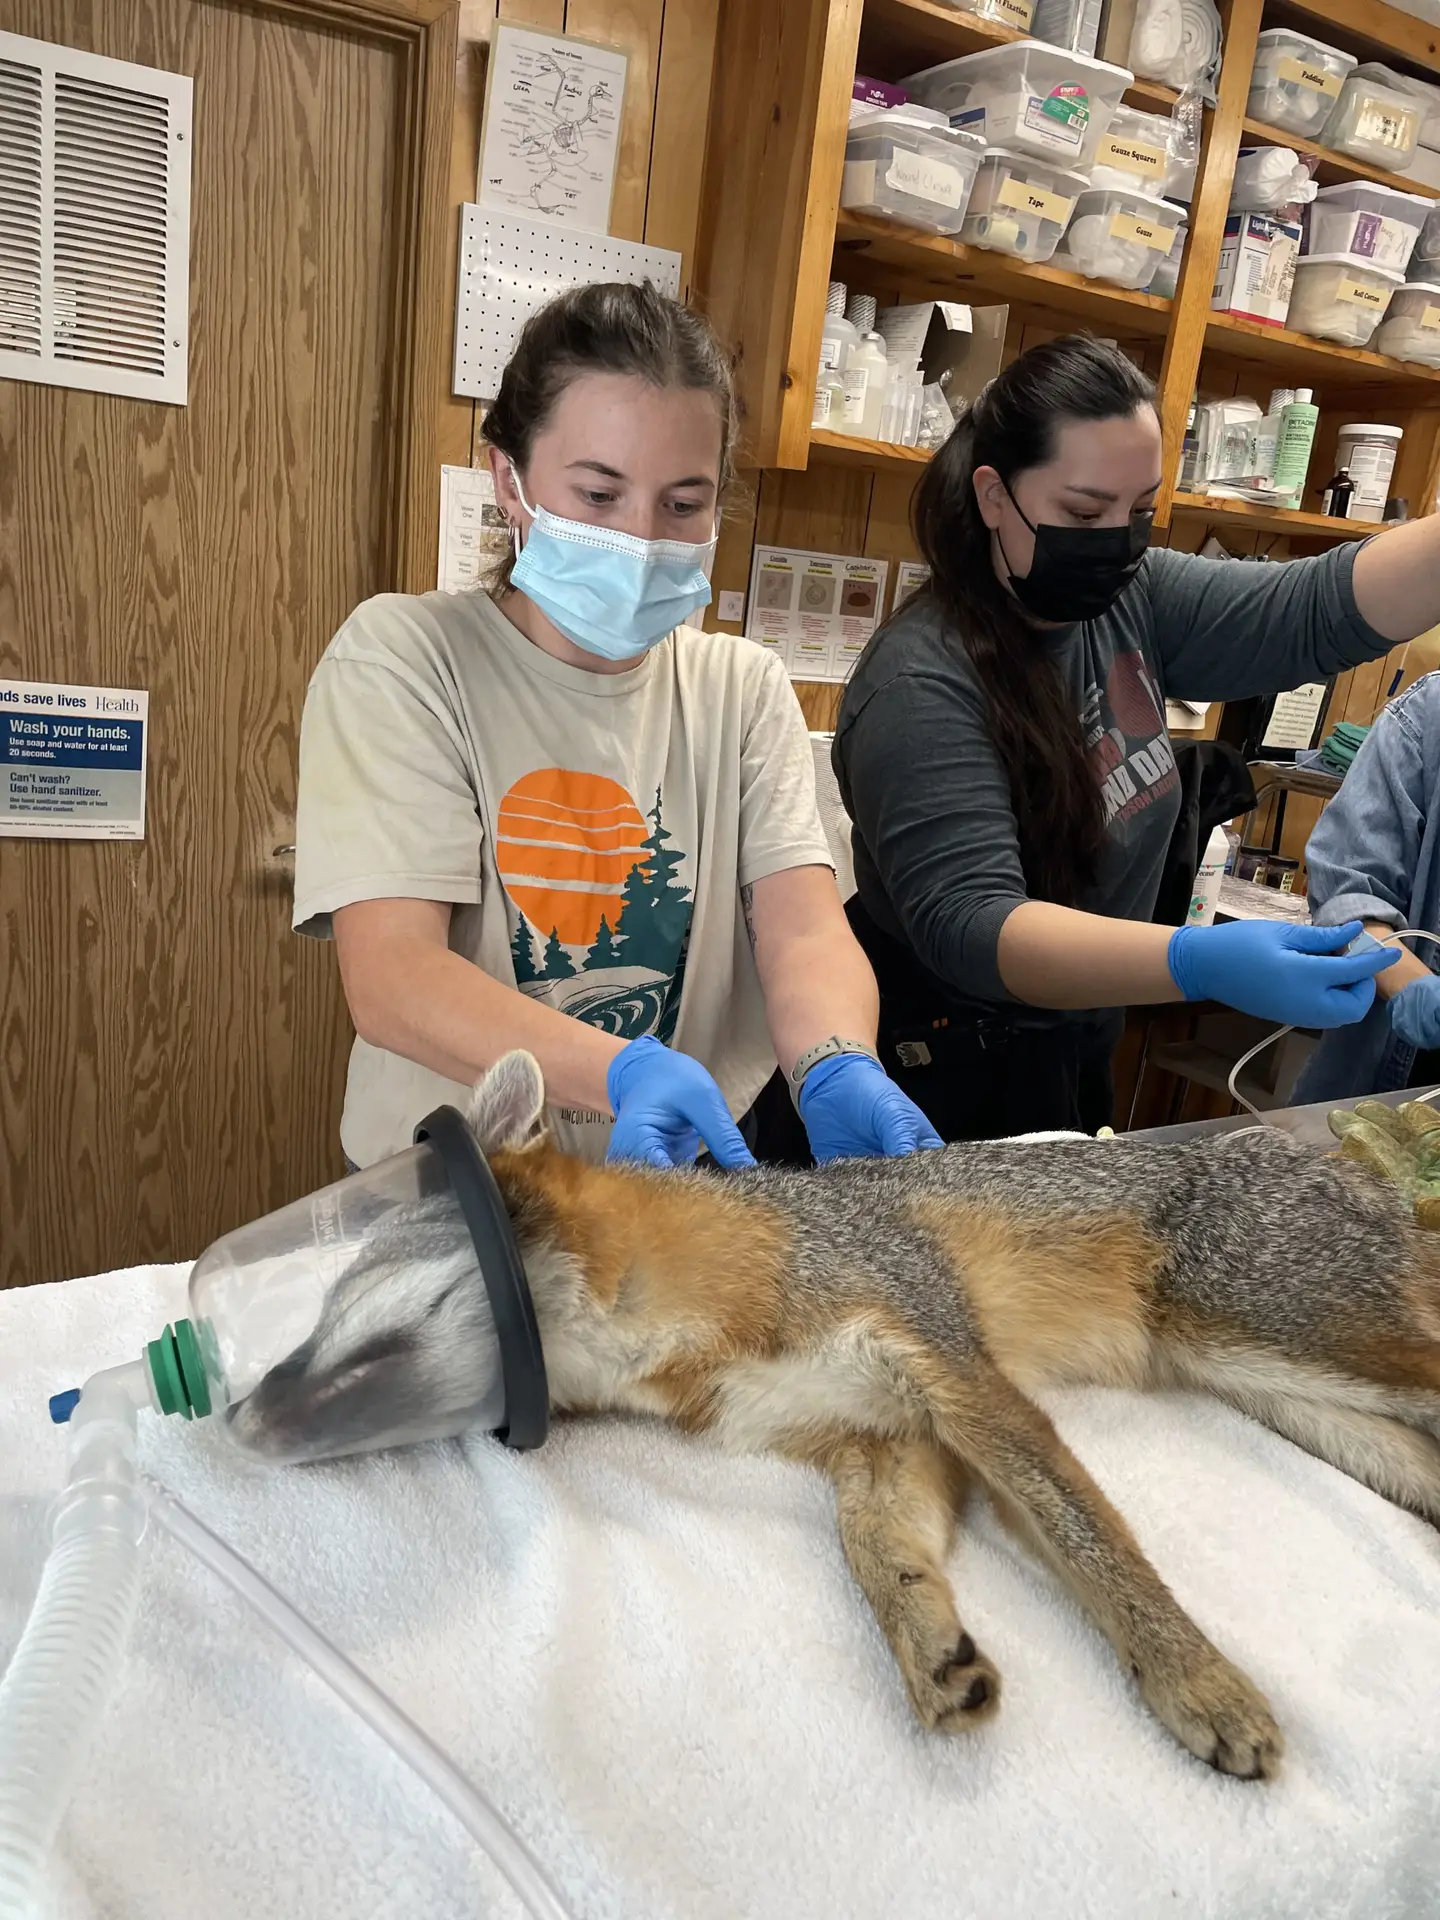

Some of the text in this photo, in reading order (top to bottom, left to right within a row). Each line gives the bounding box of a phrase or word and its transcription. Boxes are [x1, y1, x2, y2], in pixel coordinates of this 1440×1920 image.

[1002, 0, 1028, 18] Fixation
[1302, 70, 1324, 86] Padding
[1110, 145, 1157, 164] Gauze Squares
[1028, 196, 1044, 208] Tape
[1136, 226, 1152, 238] Gauze
[1364, 291, 1380, 303] Cotton
[24, 694, 53, 706] save
[58, 694, 86, 708] lives
[96, 696, 139, 712] Health
[9, 719, 131, 740] Wash your hands.
[9, 737, 25, 746] Use
[26, 740, 45, 748] soap
[47, 740, 62, 748] and
[64, 742, 86, 750] water
[88, 742, 98, 751] for
[110, 744, 127, 752] least
[9, 748, 57, 759] 20 seconds.
[10, 772, 71, 784] Can't wash?
[10, 783, 102, 797] Use hand sanitizer.
